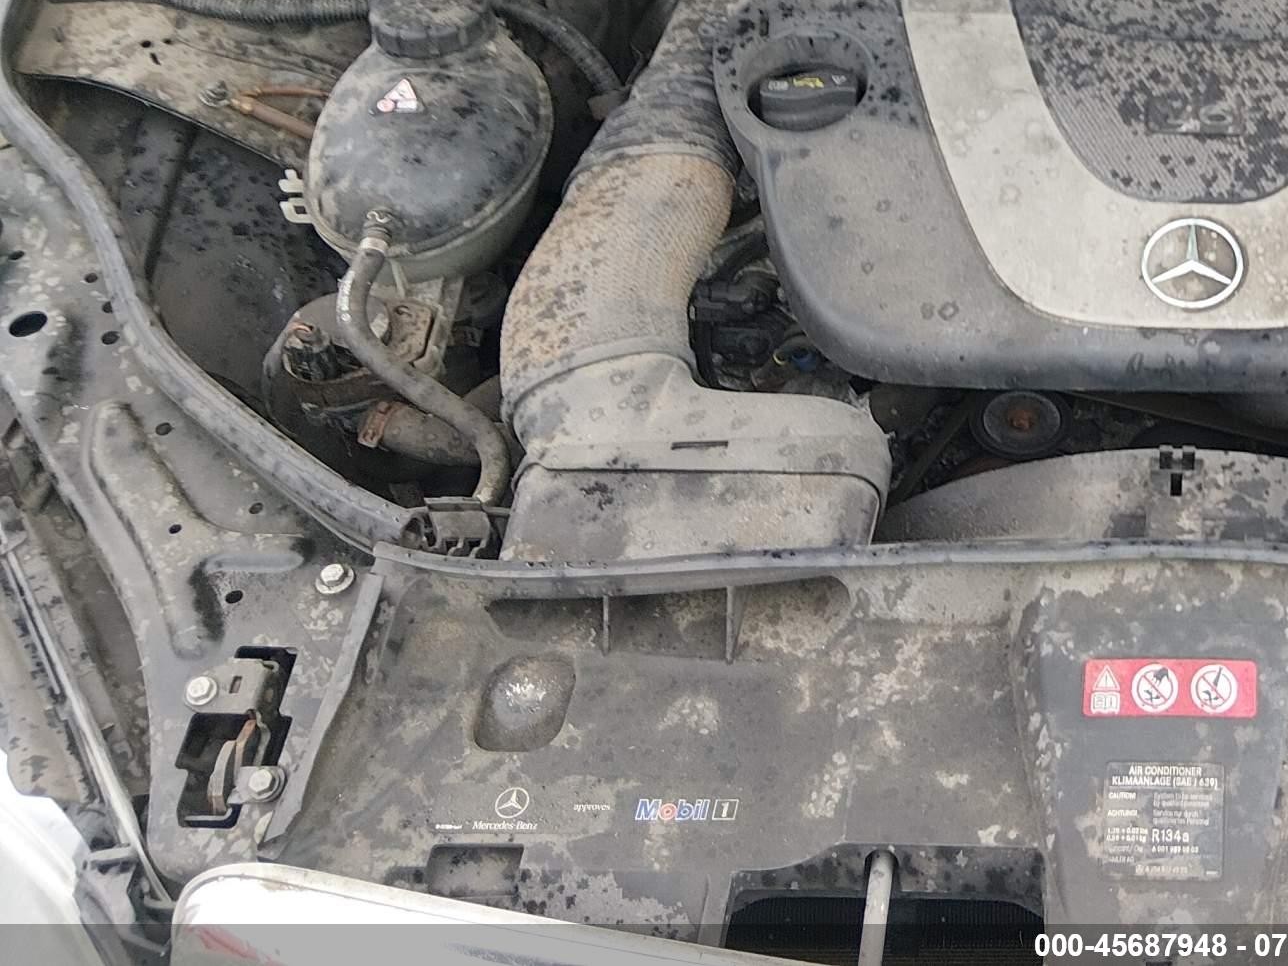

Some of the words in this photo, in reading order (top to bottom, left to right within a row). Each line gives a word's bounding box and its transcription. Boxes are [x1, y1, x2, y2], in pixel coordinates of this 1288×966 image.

[1129, 765, 1143, 776] AIR
[1145, 765, 1202, 777] CONDITIONER
[1112, 776, 1171, 786] KLIMAANLAGE
[573, 803, 611, 813] approves
[634, 798, 711, 821] Mobil
[471, 820, 538, 830] Mercedes-Benz
[1151, 828, 1190, 843] R134a
